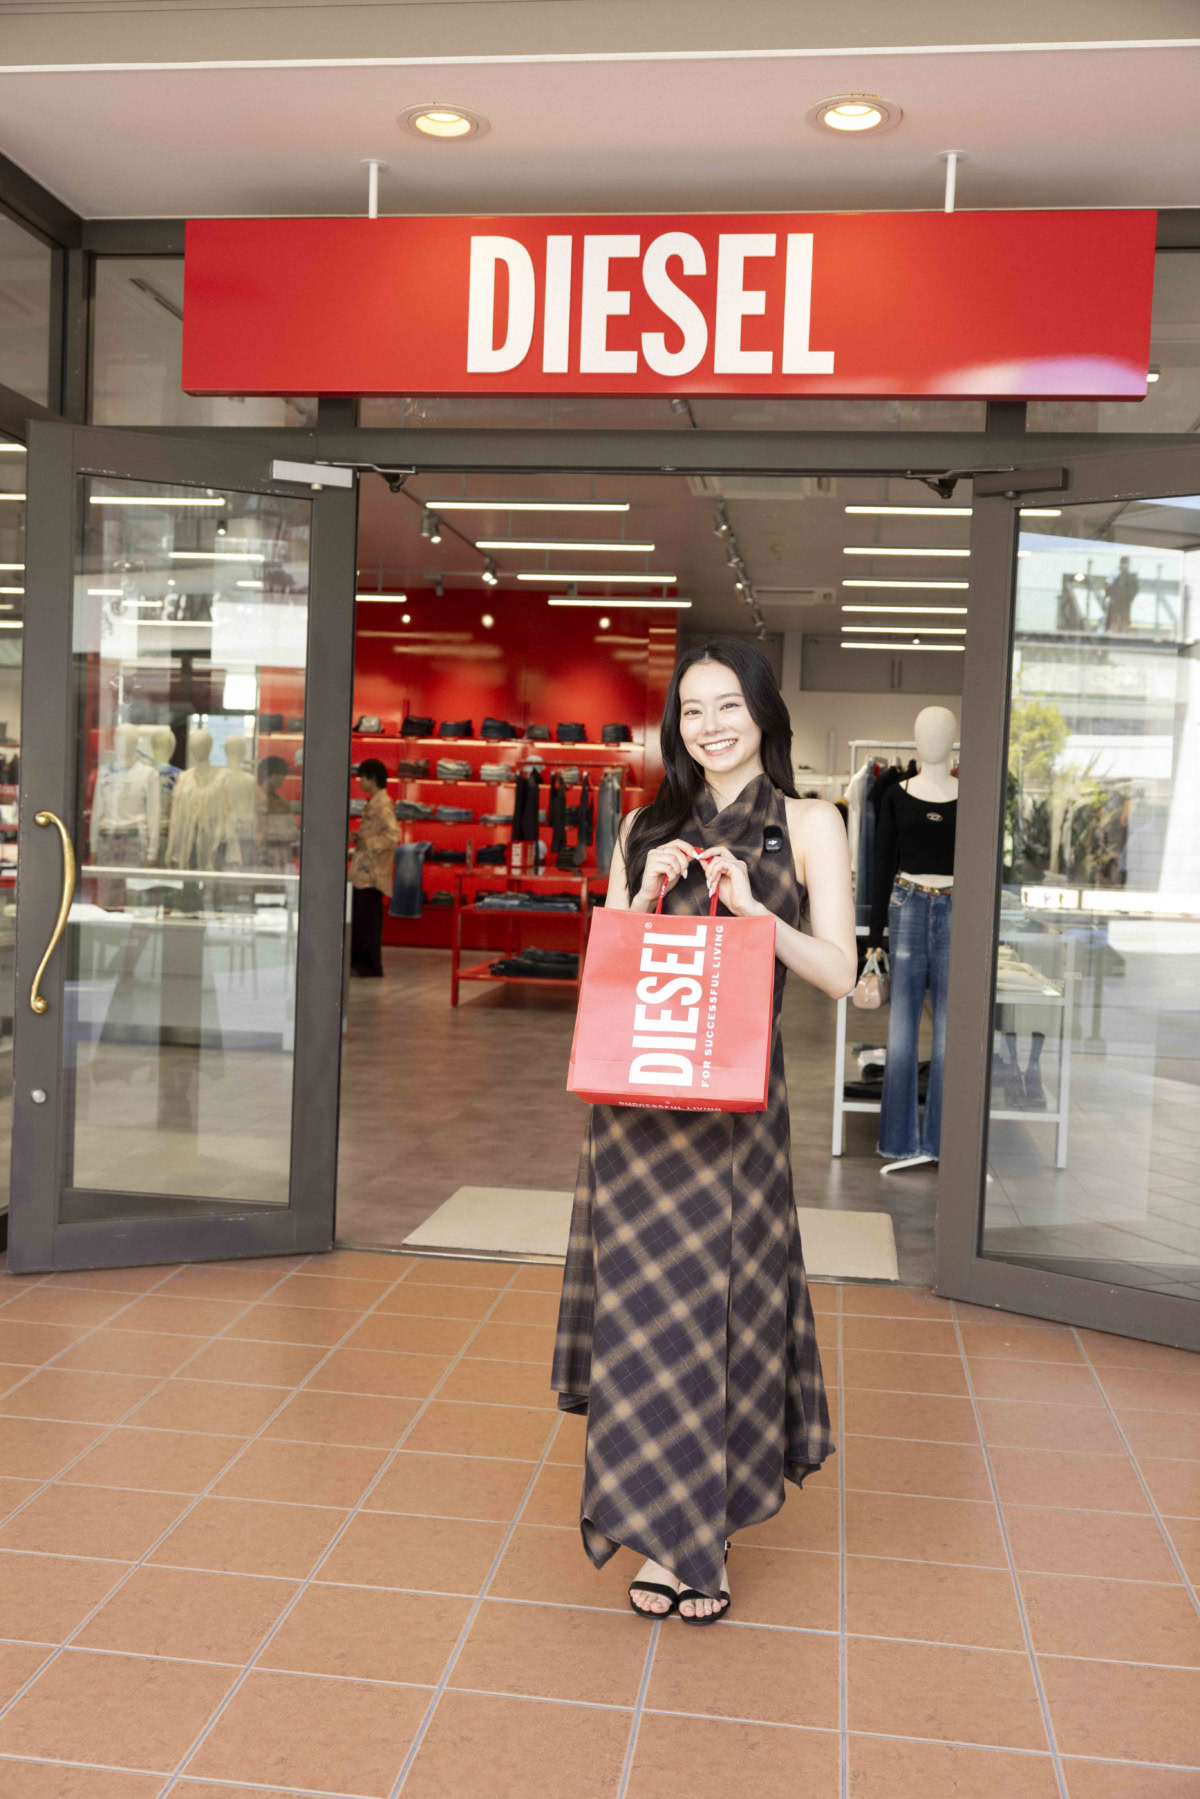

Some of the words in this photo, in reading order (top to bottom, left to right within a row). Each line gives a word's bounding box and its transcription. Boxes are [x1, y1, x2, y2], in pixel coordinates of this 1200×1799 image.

[466, 231, 835, 377] DIESEL
[712, 925, 724, 968] LIVING
[704, 972, 720, 1056] SUCCESSFUL
[701, 1060, 712, 1088] FOR
